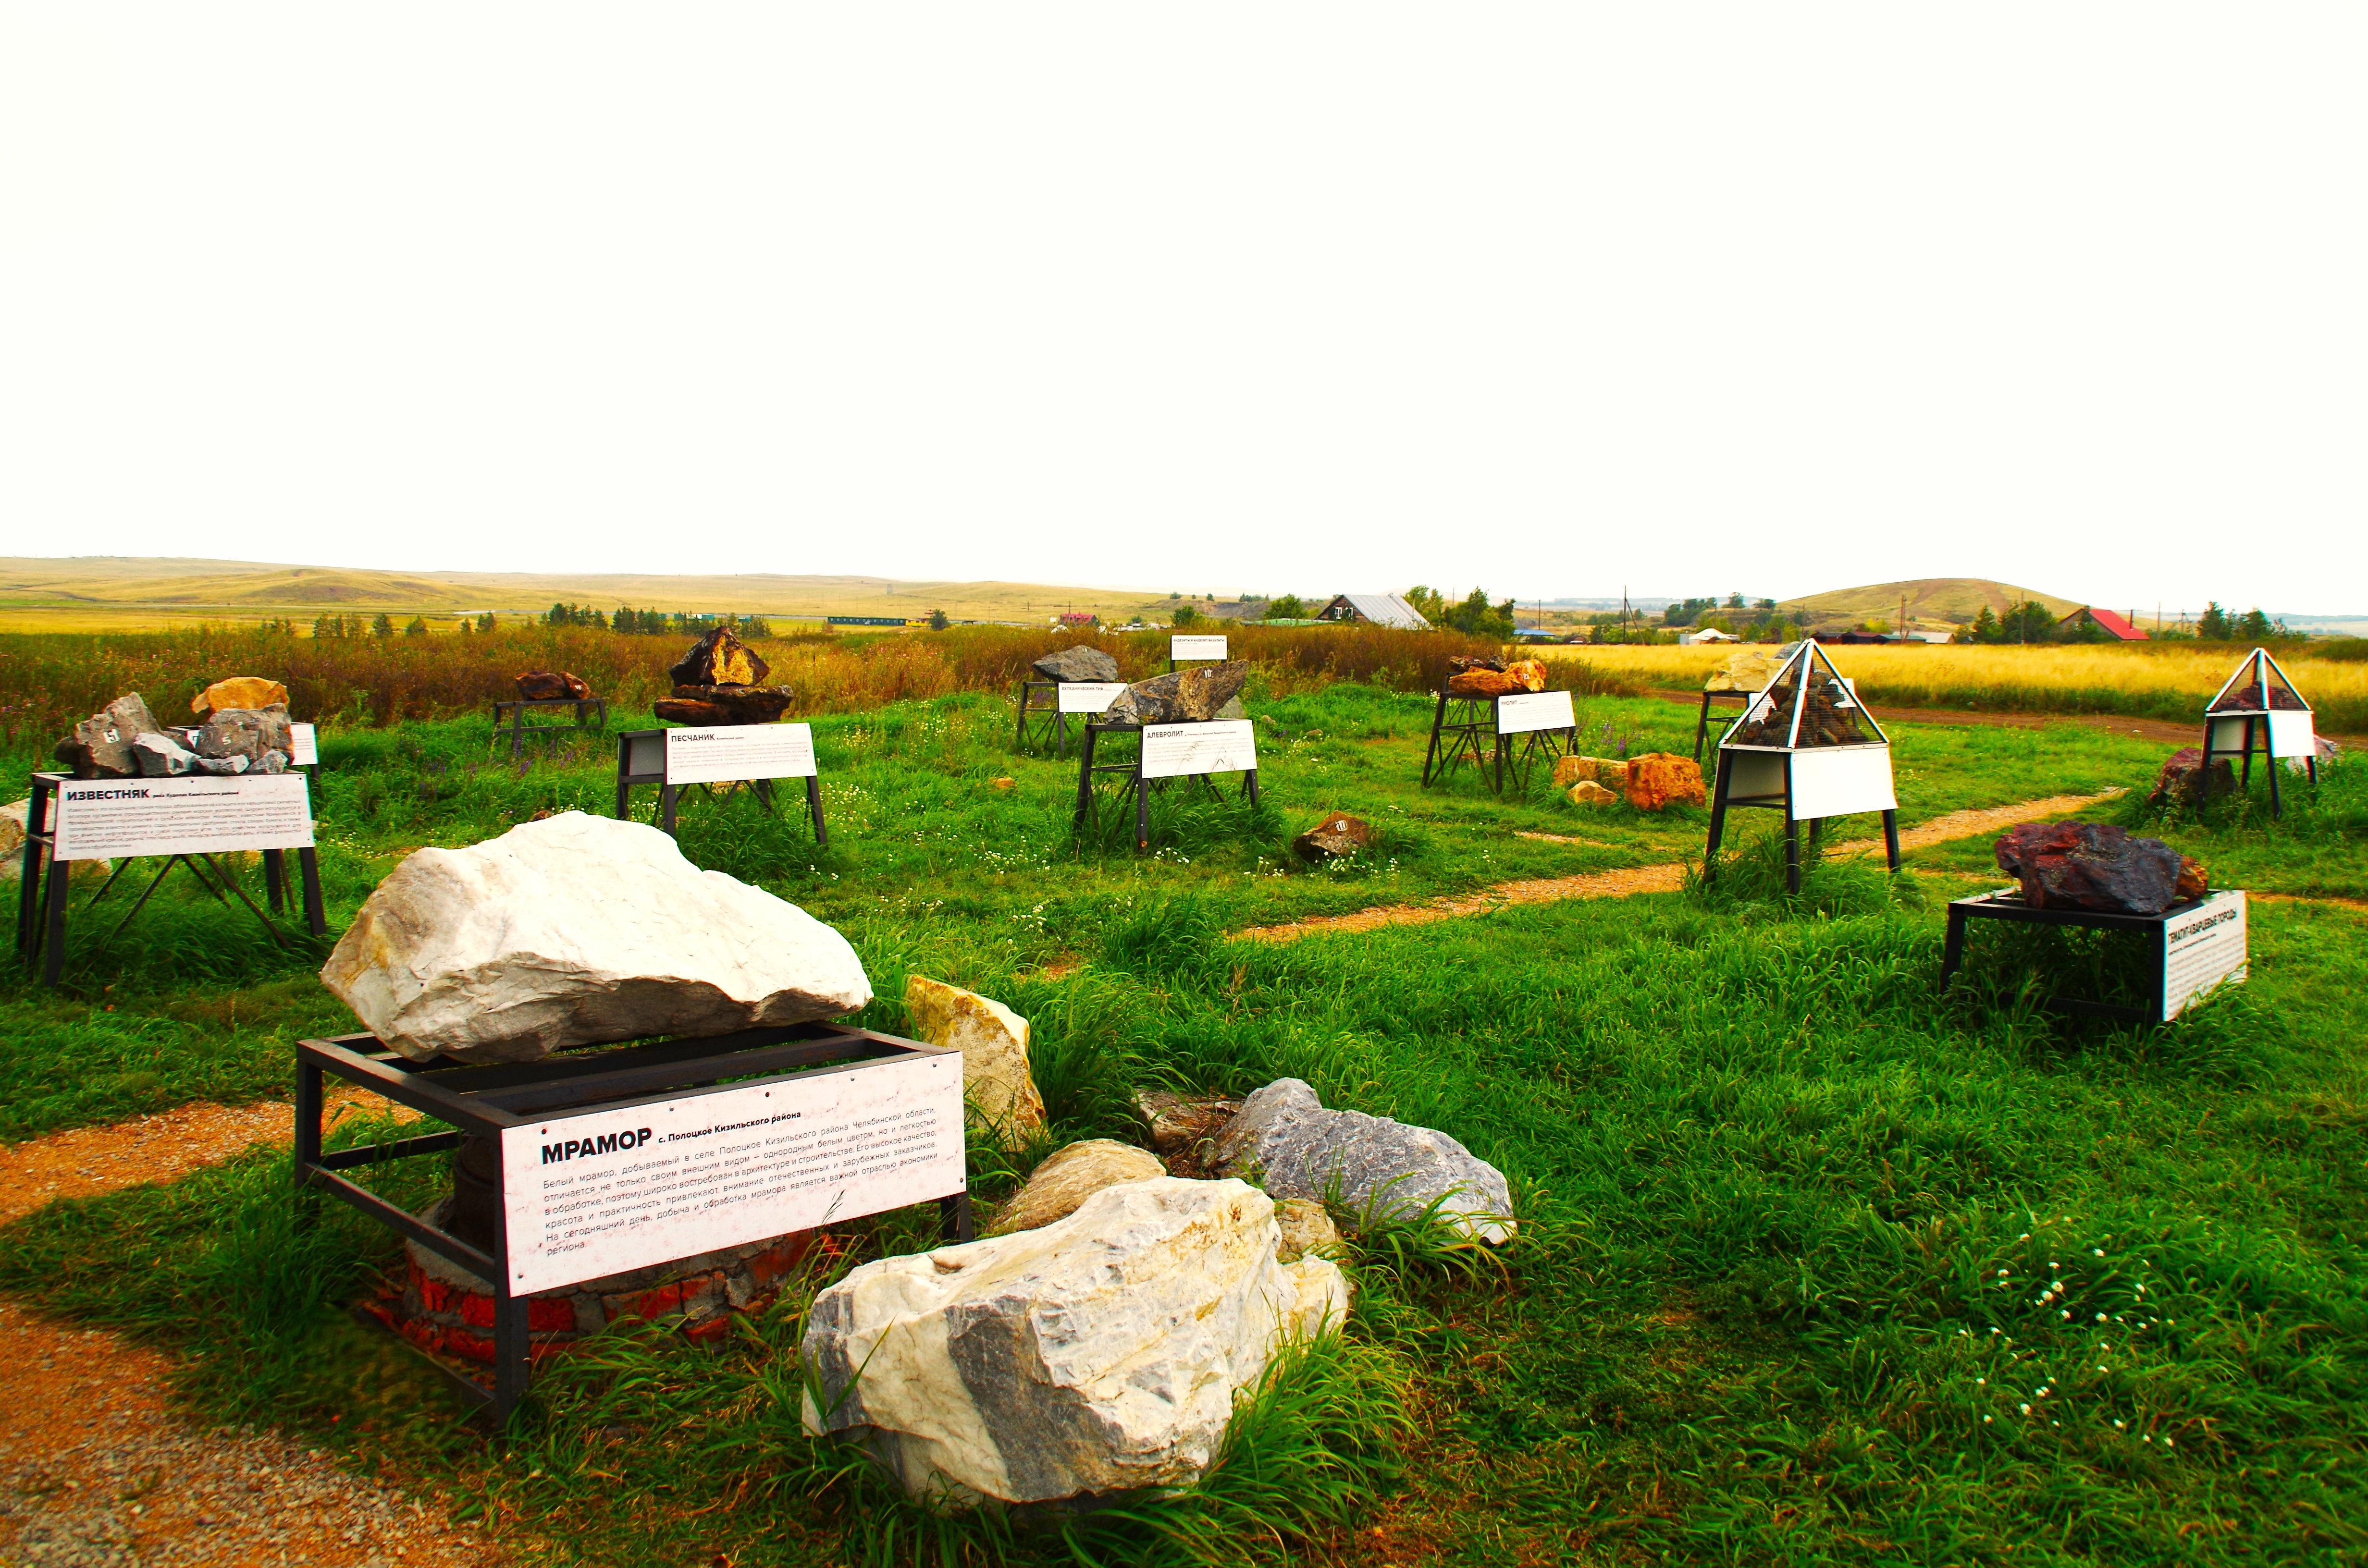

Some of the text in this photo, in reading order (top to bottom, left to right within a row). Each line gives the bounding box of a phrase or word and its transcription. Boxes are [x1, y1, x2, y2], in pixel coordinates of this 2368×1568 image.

[671, 734, 715, 742] ПЕСЧАНИК
[67, 789, 150, 801] ИЗВЕСТНЯК
[542, 1127, 652, 1165] МРАМОР
[668, 1128, 712, 1141] Полоцкое
[715, 1118, 769, 1133] Кизильского
[771, 1112, 801, 1125] района
[543, 1176, 573, 1189] Белый
[580, 1170, 617, 1183] мрамор,
[622, 1156, 679, 1175] добываемый
[695, 1151, 715, 1160] селе
[720, 1141, 761, 1154] Полоцкое
[766, 1131, 816, 1146] Кизильского
[821, 1125, 848, 1137] района
[852, 1115, 901, 1128] Челябинской
[906, 1108, 936, 1118] области,
[544, 1187, 595, 1202] отличается
[616, 1177, 646, 1188] только
[651, 1170, 677, 1181] своим
[682, 1162, 719, 1175] внешним
[725, 1156, 750, 1166] видом
[764, 1144, 813, 1159] однородным
[817, 1138, 842, 1148] белым
[847, 1132, 875, 1142] цветом,
[900, 1119, 936, 1131] легкостью
[553, 1199, 603, 1214] обработке,
[606, 1191, 641, 1203] поэтому
[644, 1184, 677, 1196] широко
[679, 1173, 732, 1188] востребован
[741, 1161, 789, 1176] архитектуре
[798, 1148, 855, 1164] строительстве.
[857, 1144, 869, 1152] Его
[871, 1138, 902, 1149] высокое
[904, 1131, 937, 1141] качество,
[545, 1215, 583, 1230] красота
[600, 1200, 661, 1218] практичность
[666, 1188, 718, 1205] привлекают
[723, 1178, 764, 1192] внимание
[769, 1164, 829, 1182] отечественных
[843, 1152, 889, 1166] зарубежных
[894, 1142, 937, 1156] заказчиков.
[546, 1233, 558, 1242] На
[564, 1218, 624, 1238] сегодняшний
[629, 1215, 653, 1226] день,
[657, 1206, 689, 1220] добыча
[704, 1194, 746, 1208] обработка
[751, 1186, 786, 1199] мрамора
[790, 1177, 825, 1190] является
[830, 1169, 858, 1182] важной
[862, 1162, 896, 1175] отраслью
[900, 1153, 937, 1166] экономики
[547, 1242, 587, 1257] региона.
